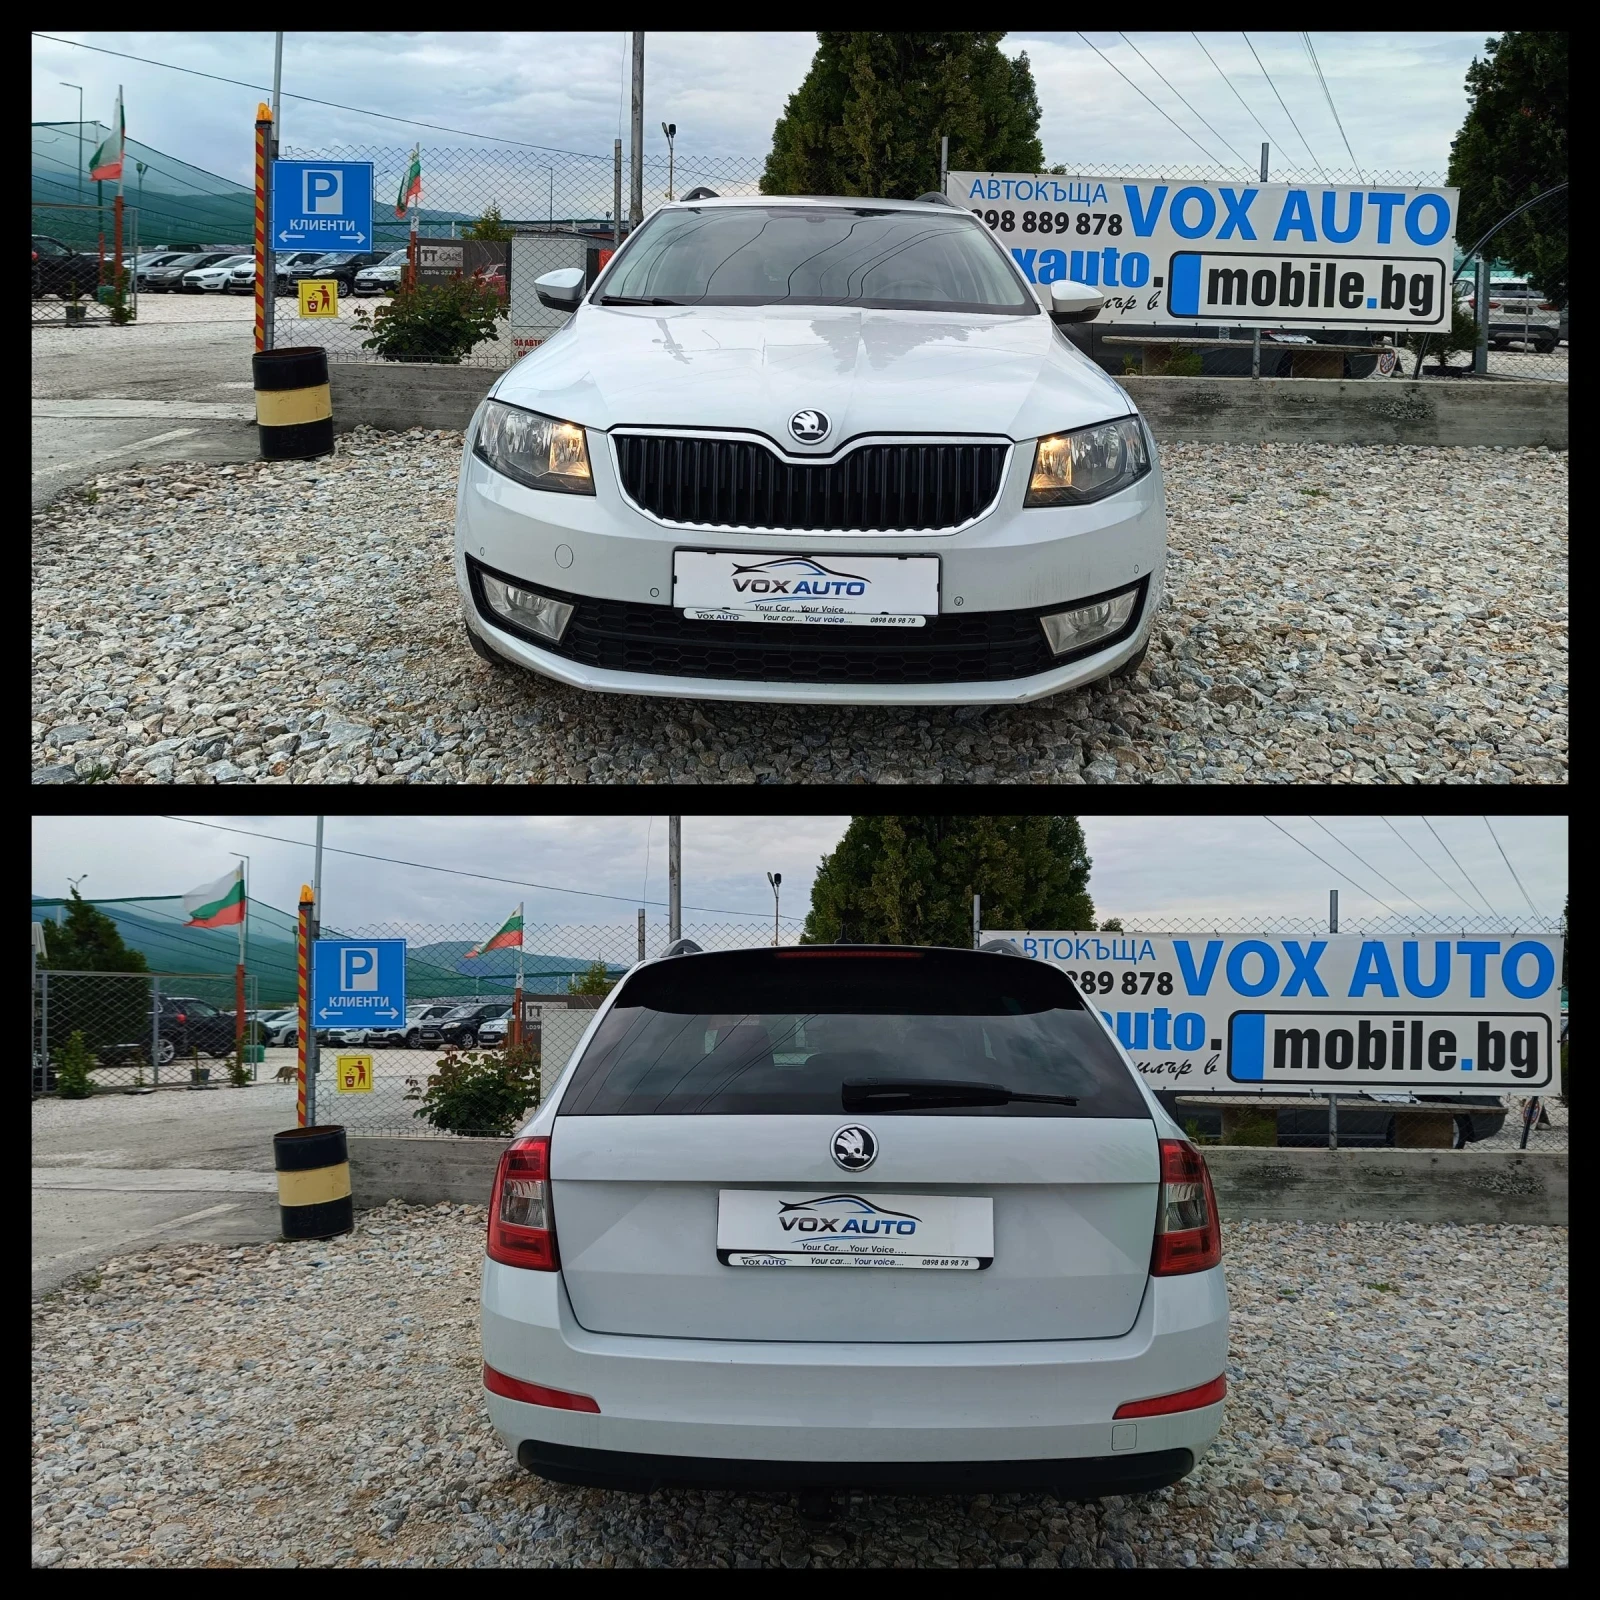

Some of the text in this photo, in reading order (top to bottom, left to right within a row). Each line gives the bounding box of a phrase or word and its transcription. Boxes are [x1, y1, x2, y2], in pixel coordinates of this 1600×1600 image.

[307, 171, 338, 212] P
[969, 178, 1108, 207] АВТОКЪЩА
[289, 218, 356, 232] КЛИЕНТИ
[1022, 210, 1069, 234] 889
[1075, 212, 1123, 237] 878
[1122, 184, 1452, 247] VOX AUTO
[1206, 261, 1435, 316] mobile.bg
[524, 339, 545, 347] АВТО
[732, 579, 865, 595] VOX AUTO
[762, 613, 780, 622] Your
[804, 614, 823, 623] Your
[1010, 938, 1156, 965] ВТОКЪЩА
[345, 950, 373, 989] P
[1172, 940, 1555, 999] VOX AUTO
[1121, 971, 1174, 996] 878
[329, 996, 389, 1008] КЛИЕНТИ
[1273, 1019, 1539, 1075] mobile.bg
[779, 1217, 916, 1234] VOX AUTO
[802, 1243, 822, 1251] Your
[742, 1258, 761, 1266] VOX
[810, 1257, 830, 1266] Your
[854, 1258, 873, 1267] Your
